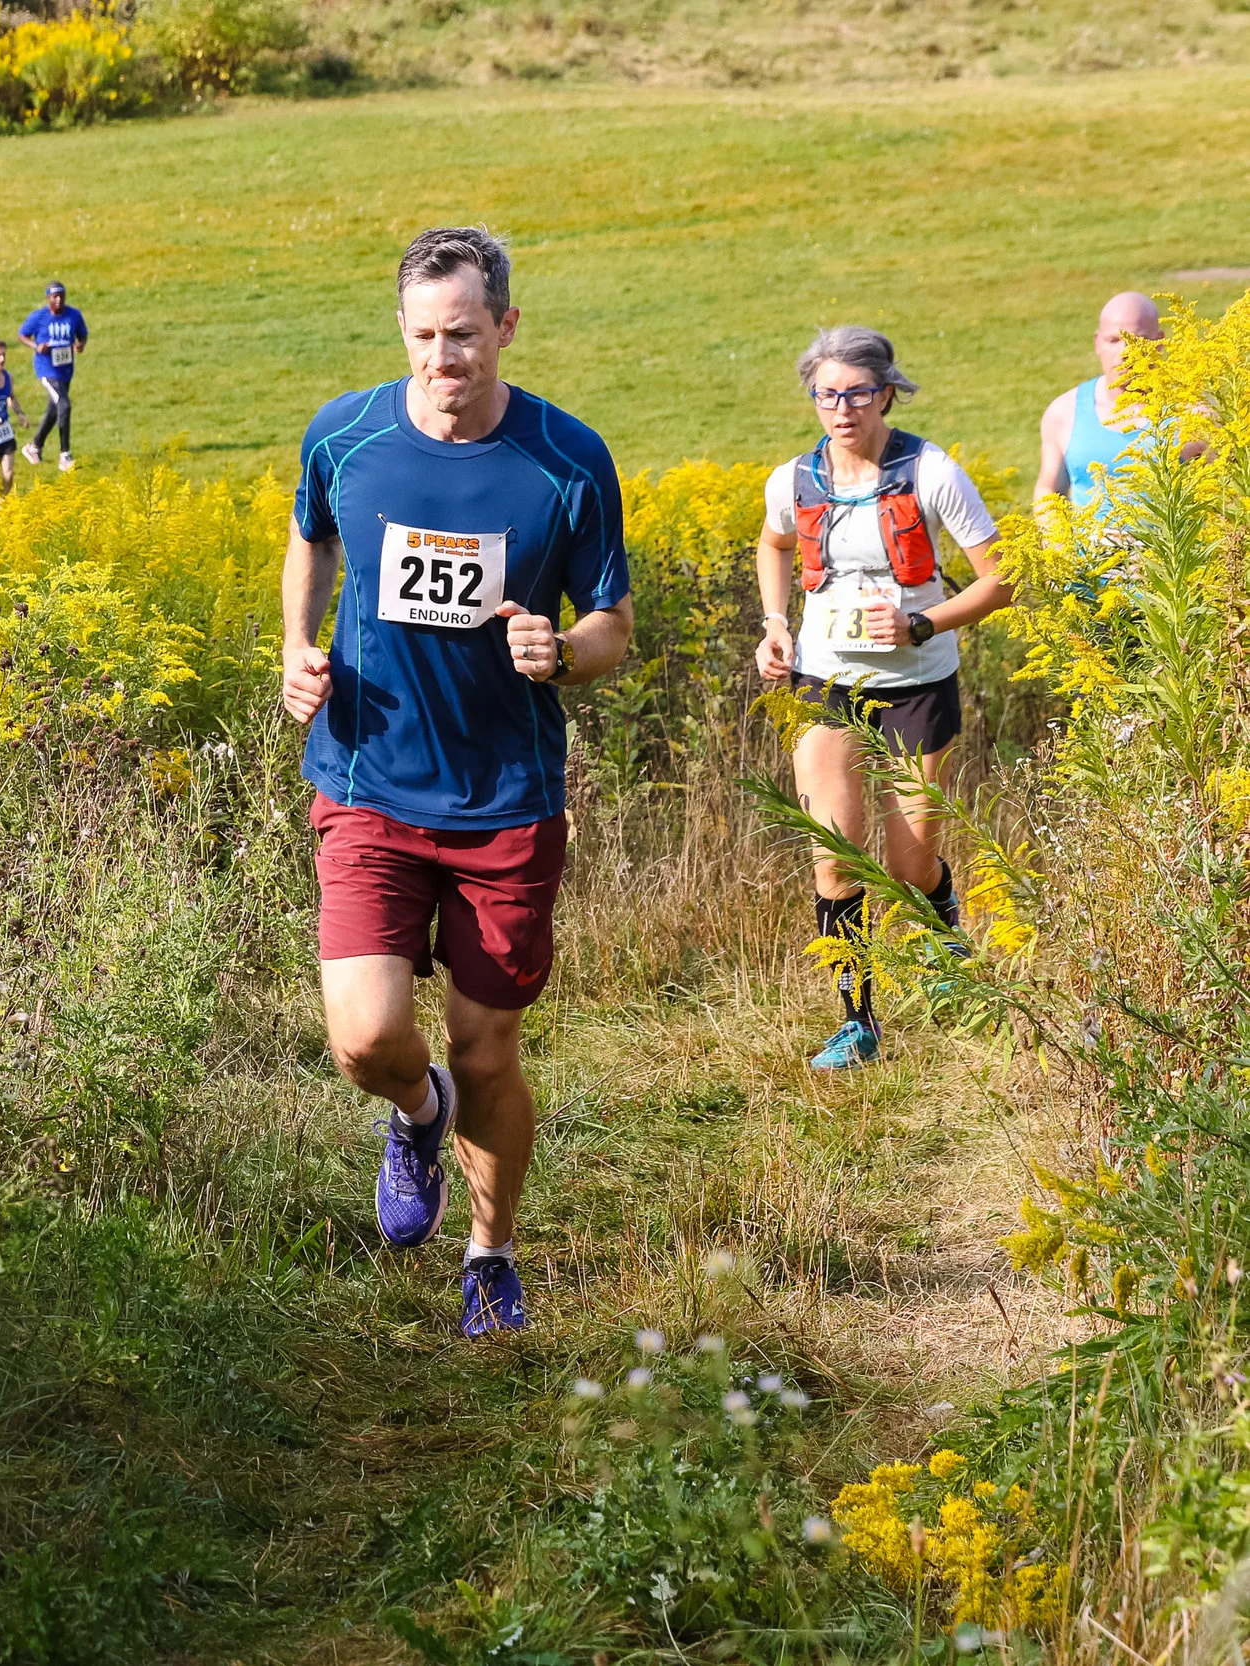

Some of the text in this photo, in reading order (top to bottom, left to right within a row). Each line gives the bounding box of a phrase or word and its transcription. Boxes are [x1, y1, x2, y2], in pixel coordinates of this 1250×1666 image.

[407, 532, 480, 550] 5 PEAKS
[400, 556, 483, 607] 252
[410, 608, 471, 625] ENDURO
[827, 608, 863, 639] 73
